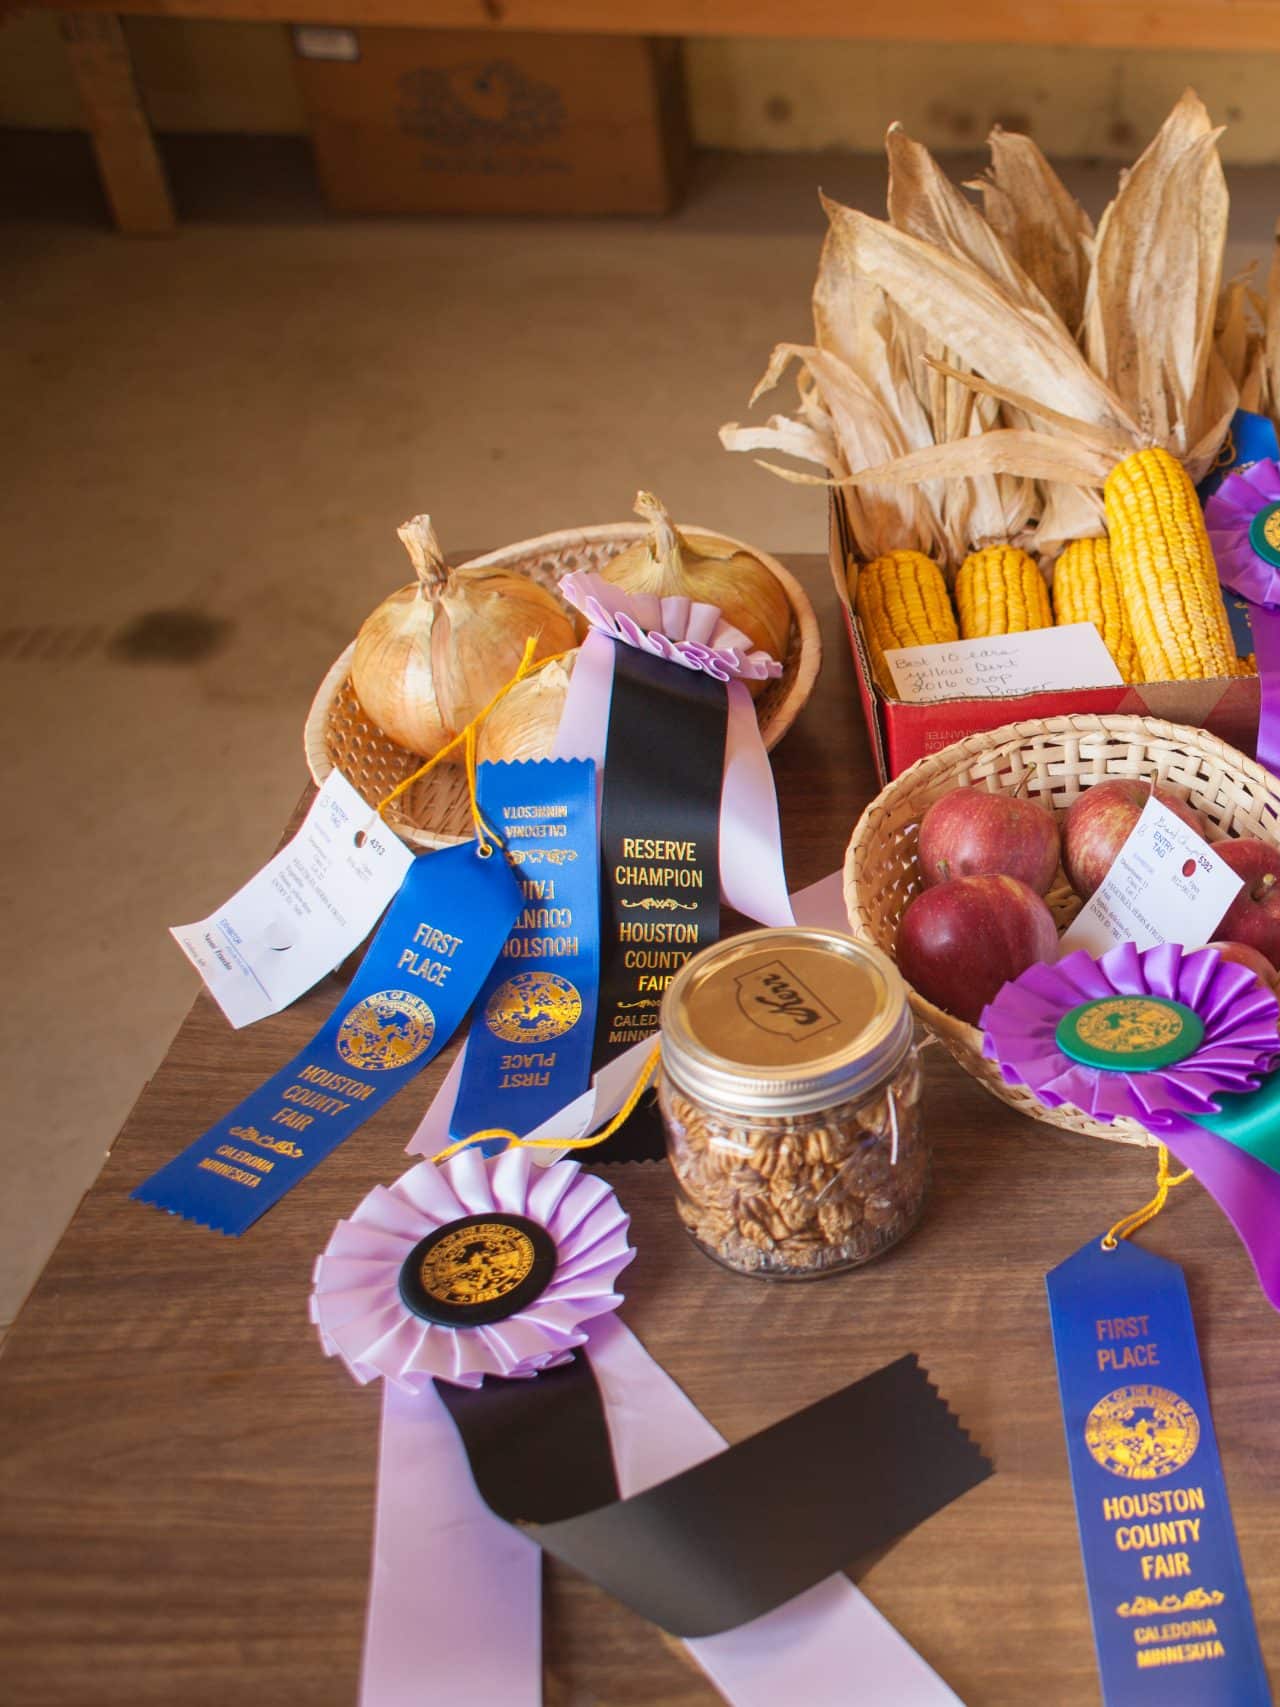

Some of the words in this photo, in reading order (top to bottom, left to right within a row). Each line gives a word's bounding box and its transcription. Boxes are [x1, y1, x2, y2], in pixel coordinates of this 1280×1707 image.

[503, 805, 568, 819] MINNESOTA
[504, 825, 567, 839] CALEDONIA
[1153, 831, 1176, 853] ENTRY
[623, 837, 697, 862] RESERVE
[1153, 842, 1167, 858] TAG
[615, 865, 703, 888] CHAMPION
[512, 908, 572, 929] COUNT
[412, 922, 463, 958] FIRST
[619, 922, 699, 944] HOUSTON
[398, 949, 452, 988] PLACE
[624, 950, 693, 969] COUNTY
[613, 1014, 659, 1028] CALED
[608, 1028, 657, 1044] MINNE
[500, 1053, 557, 1070] PLACE
[298, 1064, 377, 1101] HOUSTON
[498, 1071, 551, 1089] FIRST
[282, 1085, 351, 1117] COUNTY
[271, 1107, 315, 1132] FAIR
[215, 1144, 276, 1174] CALEDONIA
[198, 1157, 263, 1189] MINNESOTA
[1096, 1315, 1150, 1341] FIRST
[1096, 1343, 1161, 1372] PLACE
[1102, 1487, 1206, 1521] HOUSTON
[1115, 1518, 1201, 1551] COUNTY
[1140, 1551, 1192, 1581] FAIR
[1133, 1617, 1218, 1645] CALEDONIA
[1136, 1640, 1226, 1669] MINNESOTA
